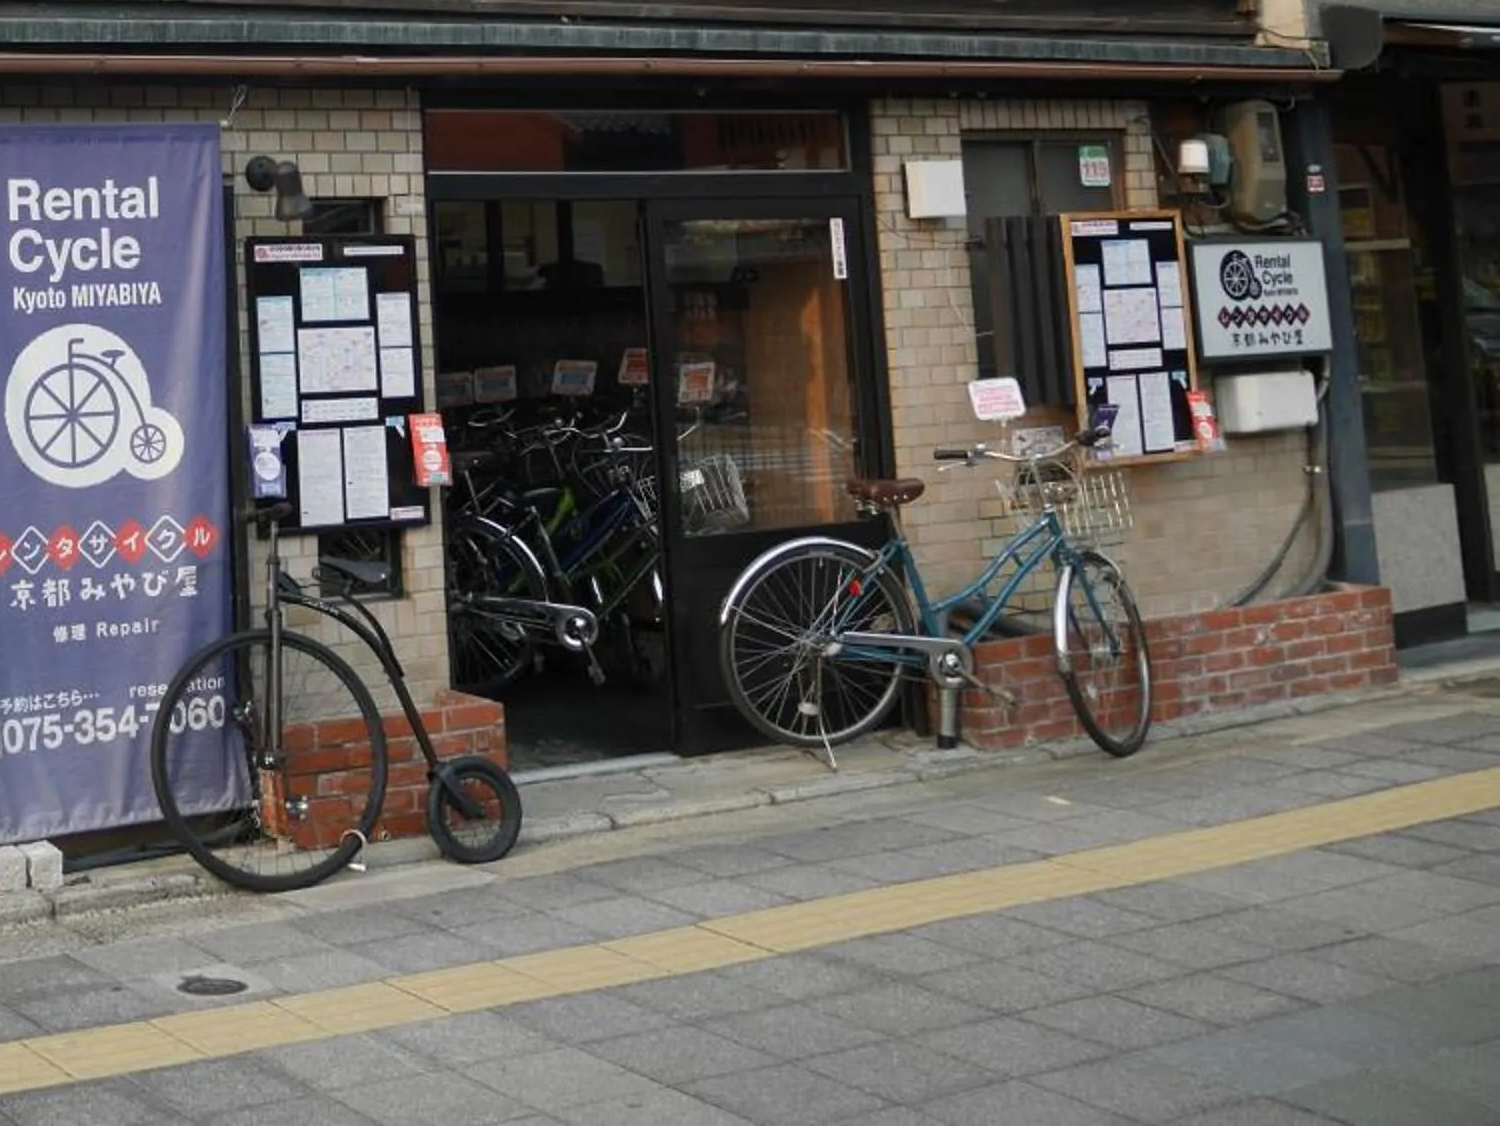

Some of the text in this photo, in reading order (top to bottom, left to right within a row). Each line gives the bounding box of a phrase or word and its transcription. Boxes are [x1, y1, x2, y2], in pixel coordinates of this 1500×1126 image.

[7, 175, 160, 222] Rental
[9, 227, 141, 282] Cycle
[1254, 253, 1291, 269] Rental
[1261, 269, 1293, 287] Cycle
[13, 282, 162, 314] Kyoto MIYABIYA
[10, 565, 198, 612] 京都みやび屋
[53, 617, 160, 643] 修理 Repair
[129, 675, 225, 699] reseation
